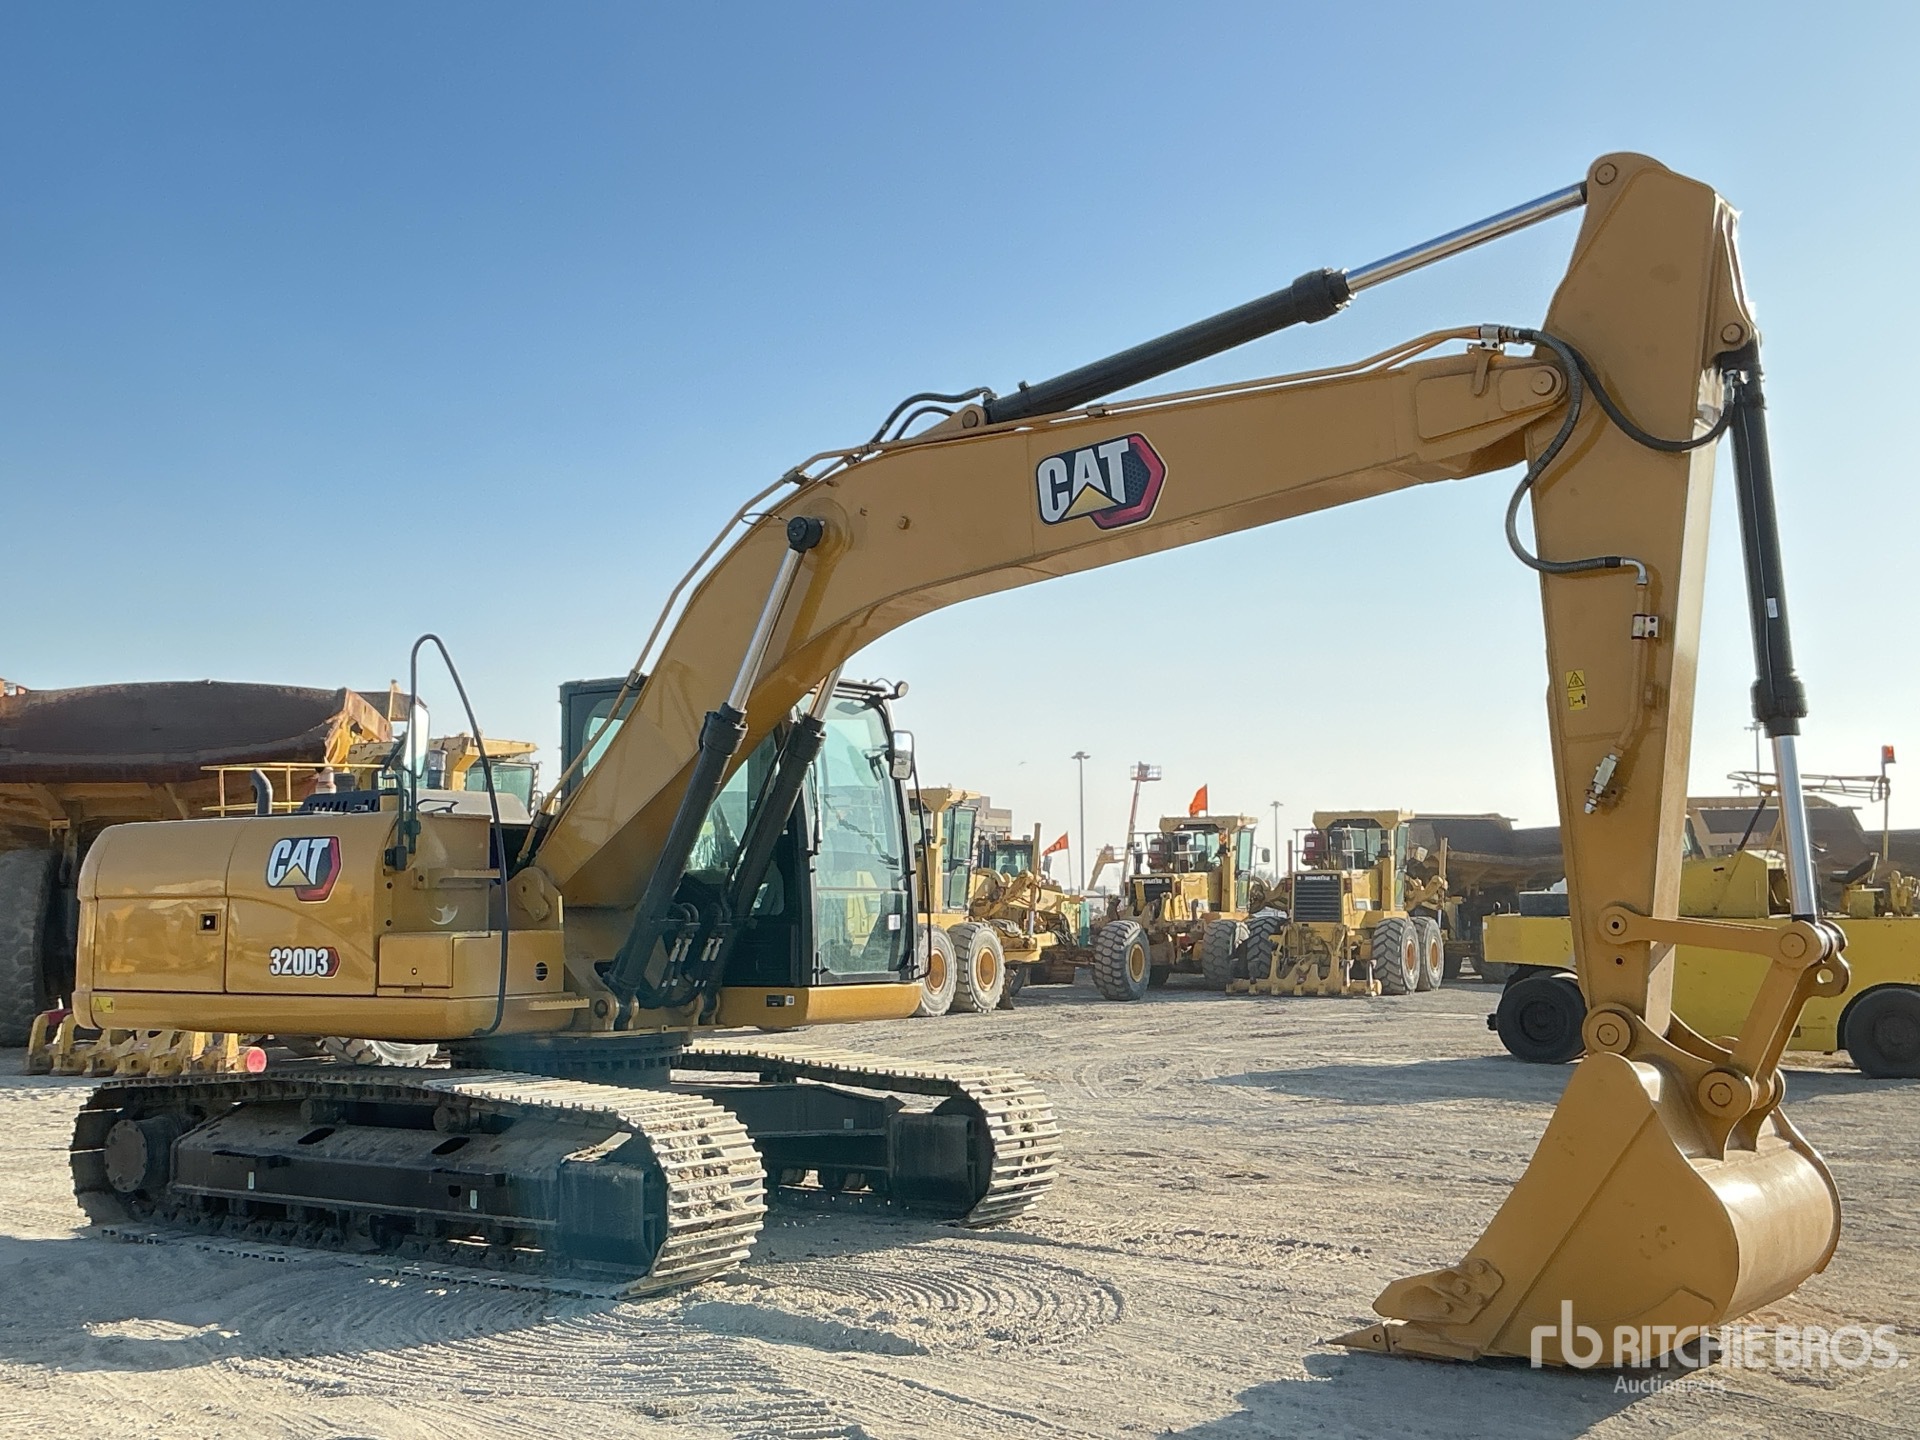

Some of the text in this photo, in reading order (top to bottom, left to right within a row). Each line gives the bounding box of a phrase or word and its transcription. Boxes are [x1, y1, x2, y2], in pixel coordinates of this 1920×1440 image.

[1037, 438, 1130, 522] CAT
[268, 838, 331, 887] CAT
[269, 948, 329, 975] 320D3
